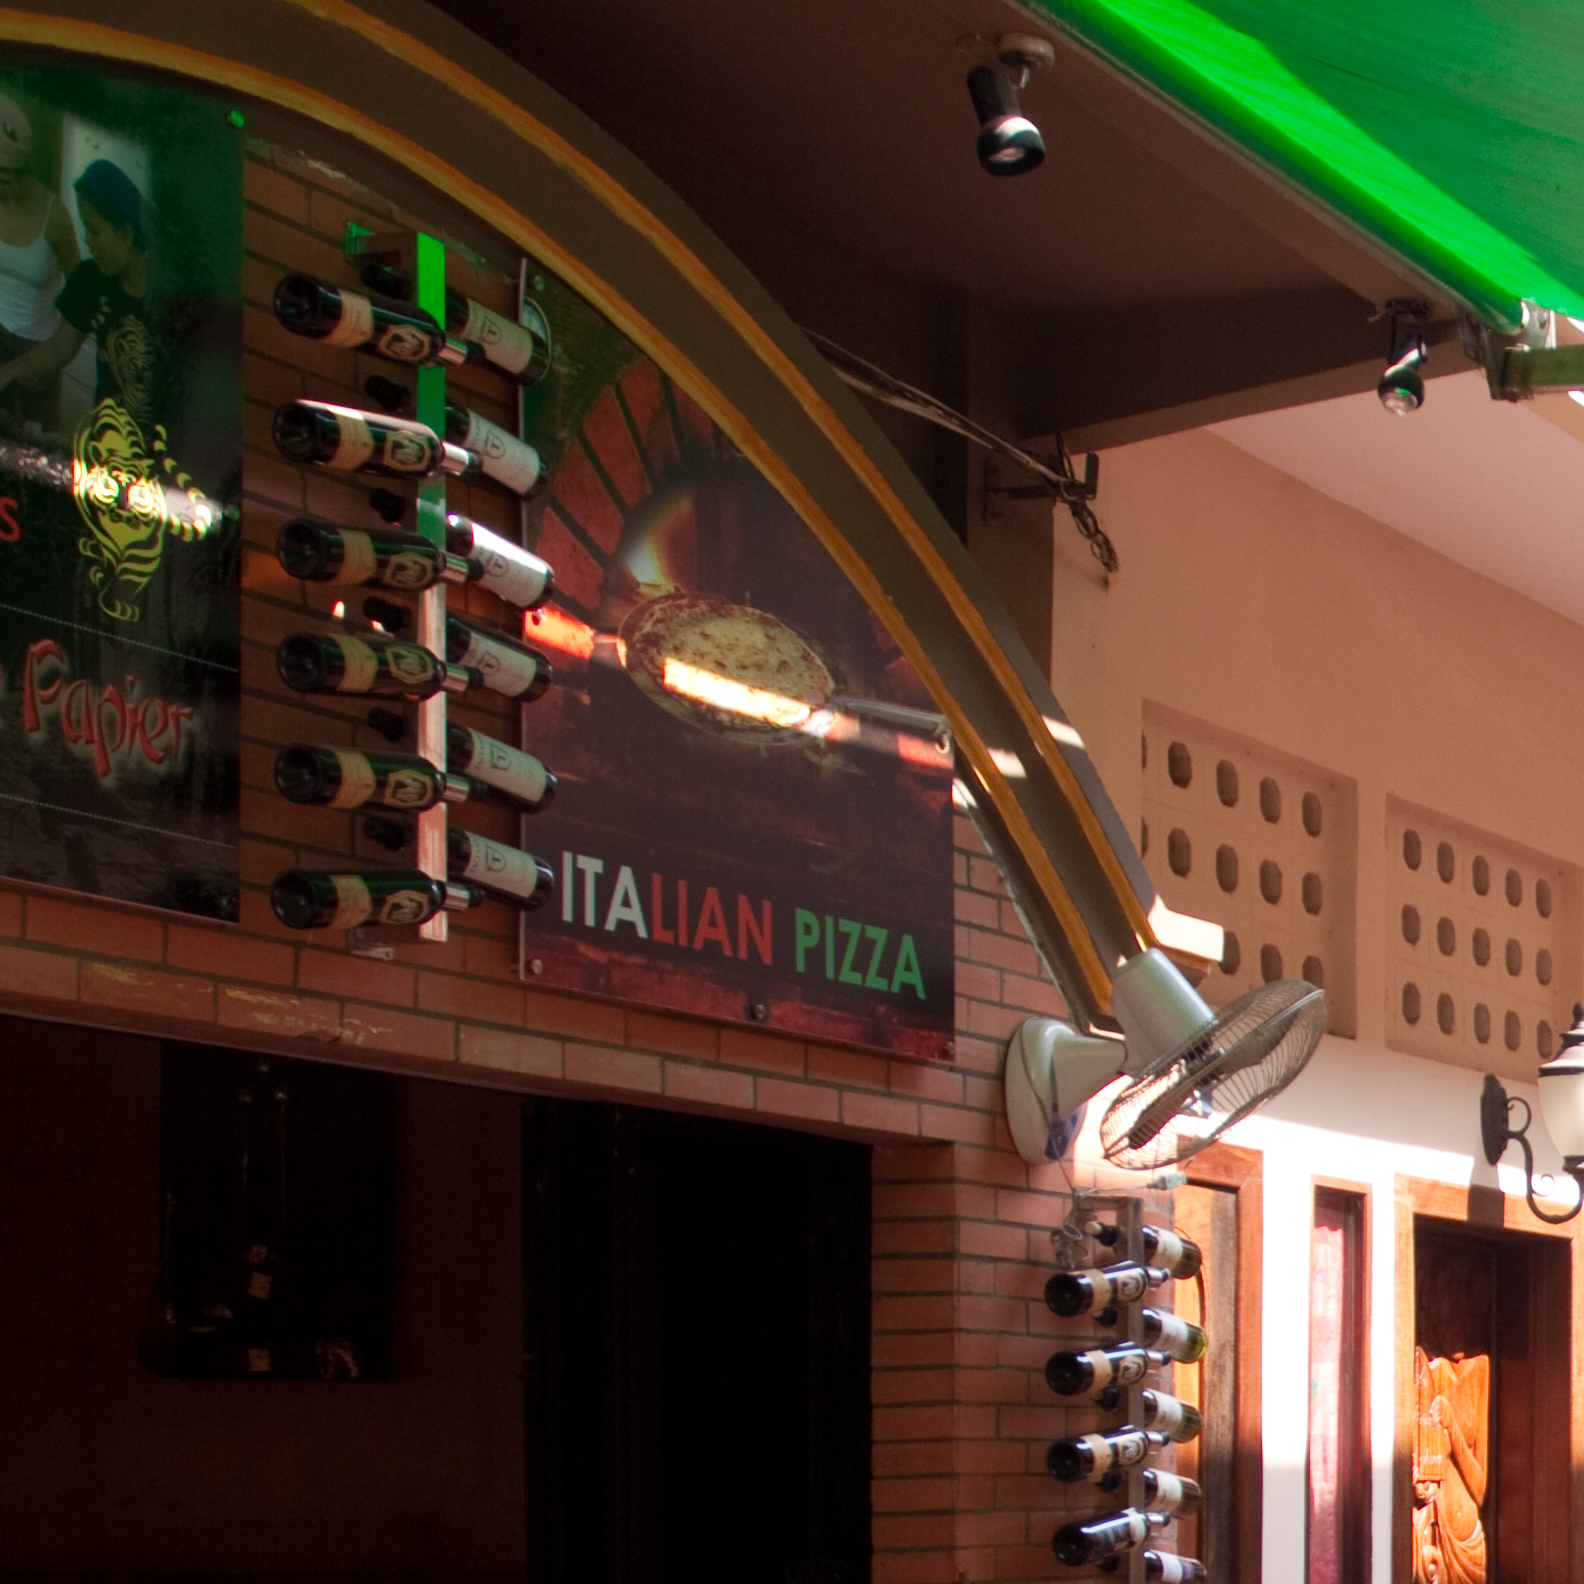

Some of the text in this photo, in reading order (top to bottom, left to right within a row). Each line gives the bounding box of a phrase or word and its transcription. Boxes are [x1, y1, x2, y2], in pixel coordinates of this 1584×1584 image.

[23, 639, 194, 778] Papier
[562, 850, 926, 999] ITALIAN PIZZA
